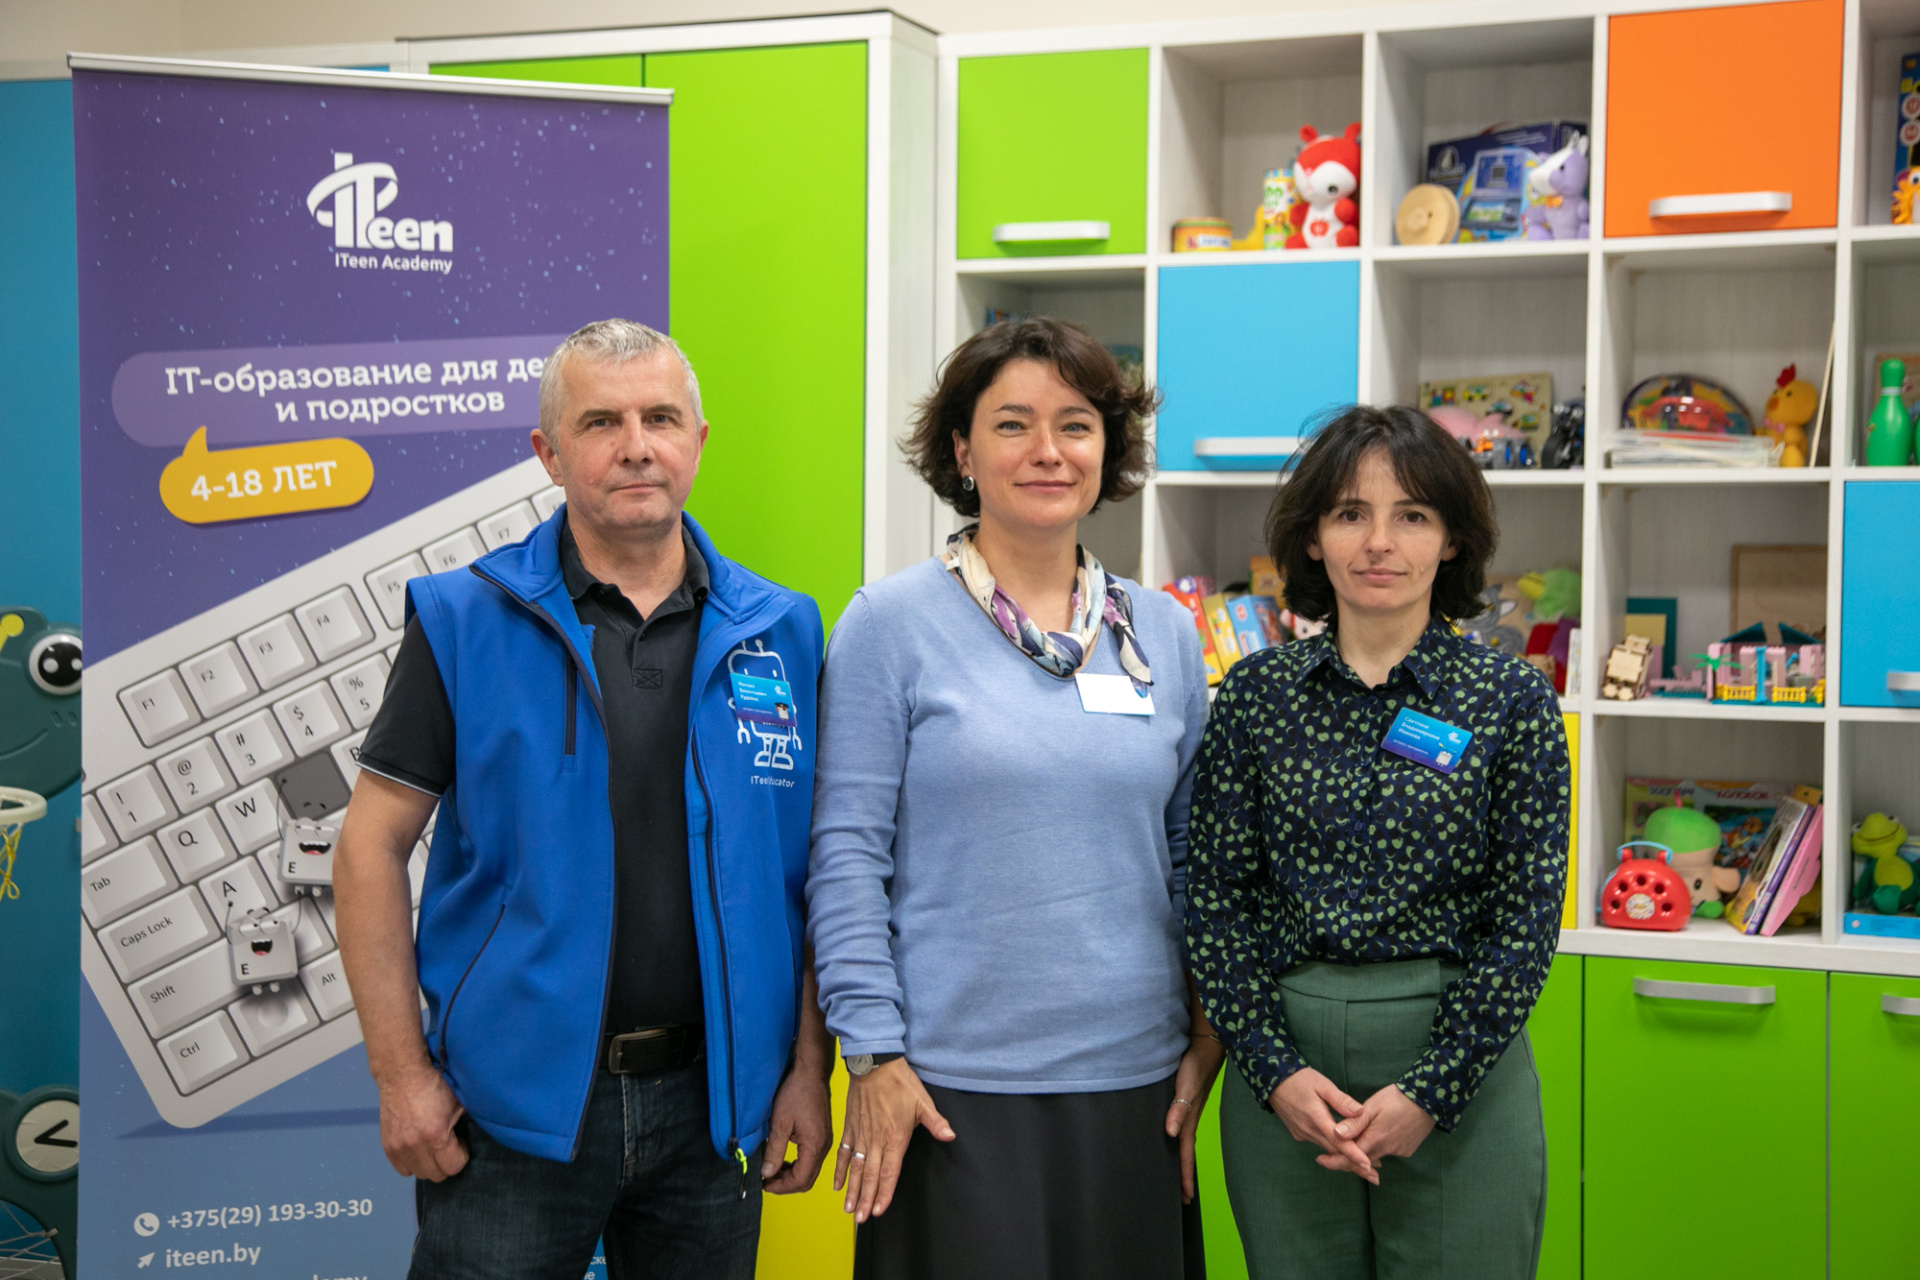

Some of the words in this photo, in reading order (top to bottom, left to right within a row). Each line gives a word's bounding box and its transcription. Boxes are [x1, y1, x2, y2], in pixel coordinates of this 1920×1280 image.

[306, 152, 454, 252] ITeen
[335, 252, 378, 269] ITeen
[381, 254, 453, 275] Academy
[165, 362, 432, 397] IT-образование
[440, 359, 498, 386] для
[506, 357, 546, 383] де
[275, 401, 299, 423] и
[306, 391, 505, 424] подростков
[190, 469, 263, 501] 4-18
[273, 460, 338, 493] ЛЕТ
[498, 527, 510, 540] F7
[442, 553, 457, 567] F6
[387, 580, 401, 594] F5
[316, 614, 330, 627] F4
[259, 642, 273, 655] F3
[201, 670, 215, 683] F2
[141, 698, 155, 711] F1
[359, 697, 370, 711] 5
[305, 724, 314, 738] 4
[245, 753, 256, 767] 3
[177, 759, 192, 776] @
[186, 781, 198, 795] 2
[234, 797, 257, 818] W
[127, 811, 137, 823] 1
[177, 830, 198, 847] Q
[288, 861, 297, 874] E
[90, 877, 111, 892] Tab
[222, 880, 237, 898] A
[120, 929, 147, 948] Caps
[147, 916, 174, 935] Lock
[241, 963, 250, 976] E
[321, 972, 337, 986] Alt
[150, 984, 176, 1003] Shift
[179, 1042, 201, 1058] Ctrl
[167, 1204, 262, 1229] +375(29)
[268, 1198, 373, 1222] 193-30-30
[165, 1242, 261, 1268] iteen.by
